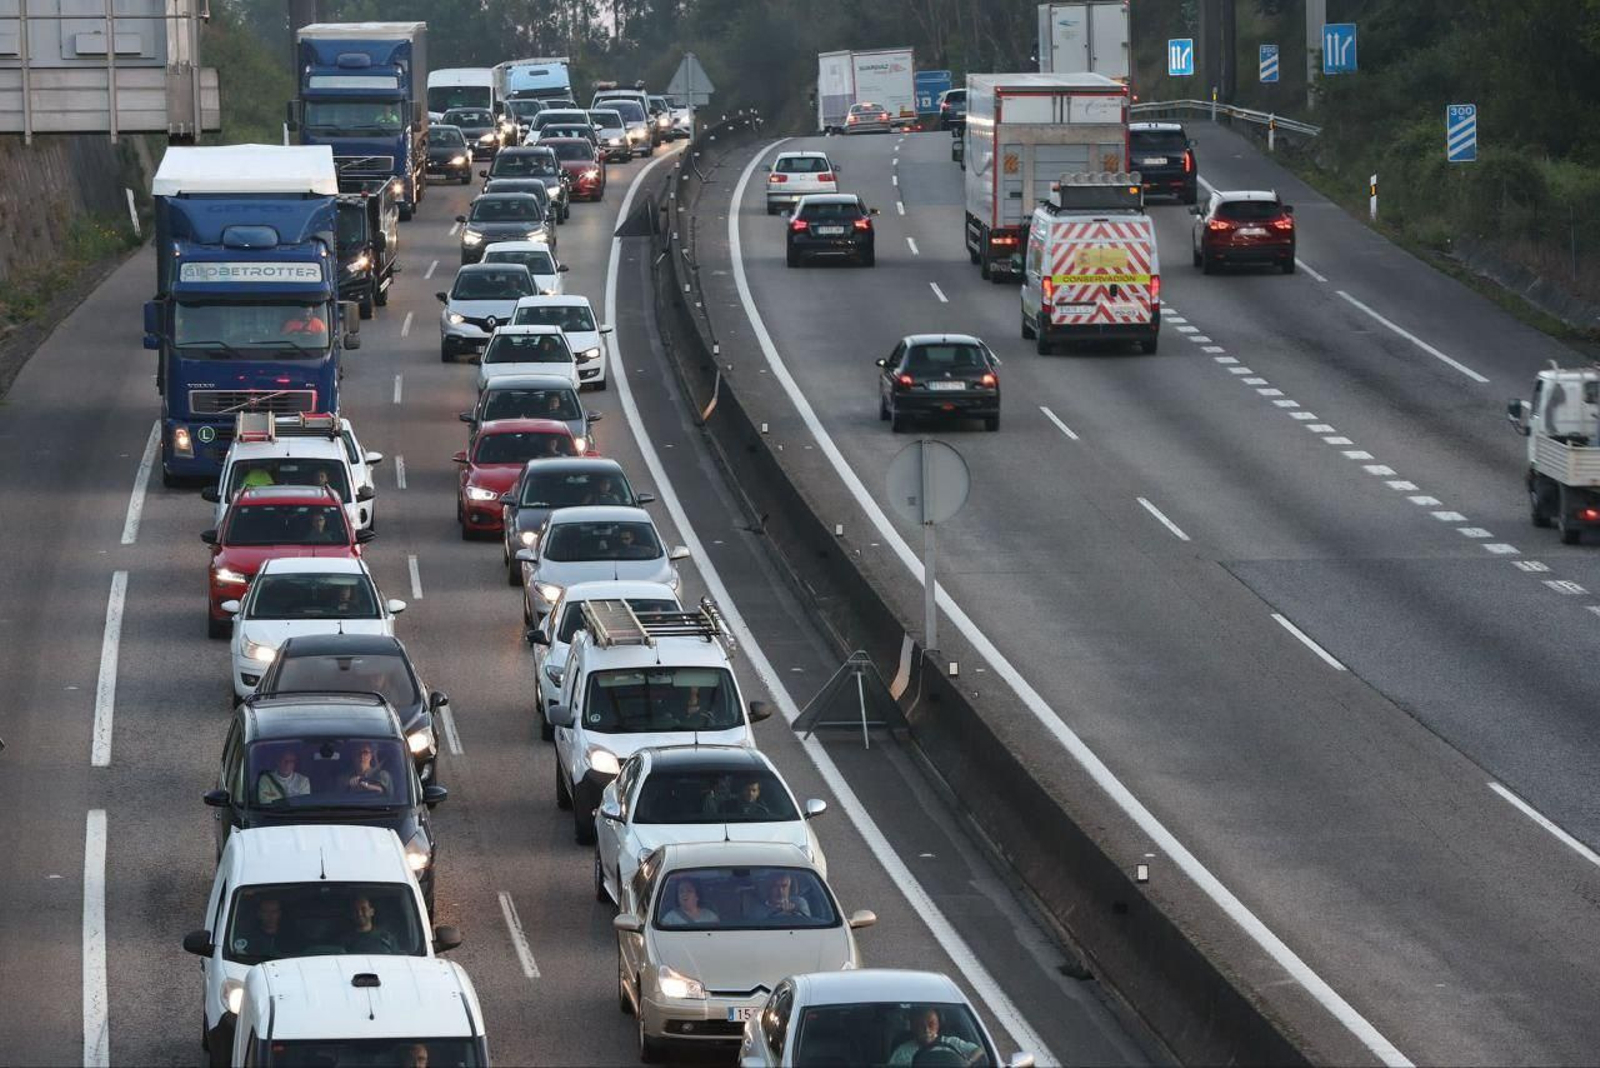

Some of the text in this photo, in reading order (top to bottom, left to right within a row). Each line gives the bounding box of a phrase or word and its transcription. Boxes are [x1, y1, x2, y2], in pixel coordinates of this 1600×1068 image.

[1450, 107, 1473, 116] 300
[184, 266, 317, 277] GLOBETROTTER
[202, 427, 211, 440] L
[738, 1008, 758, 1020] 15
